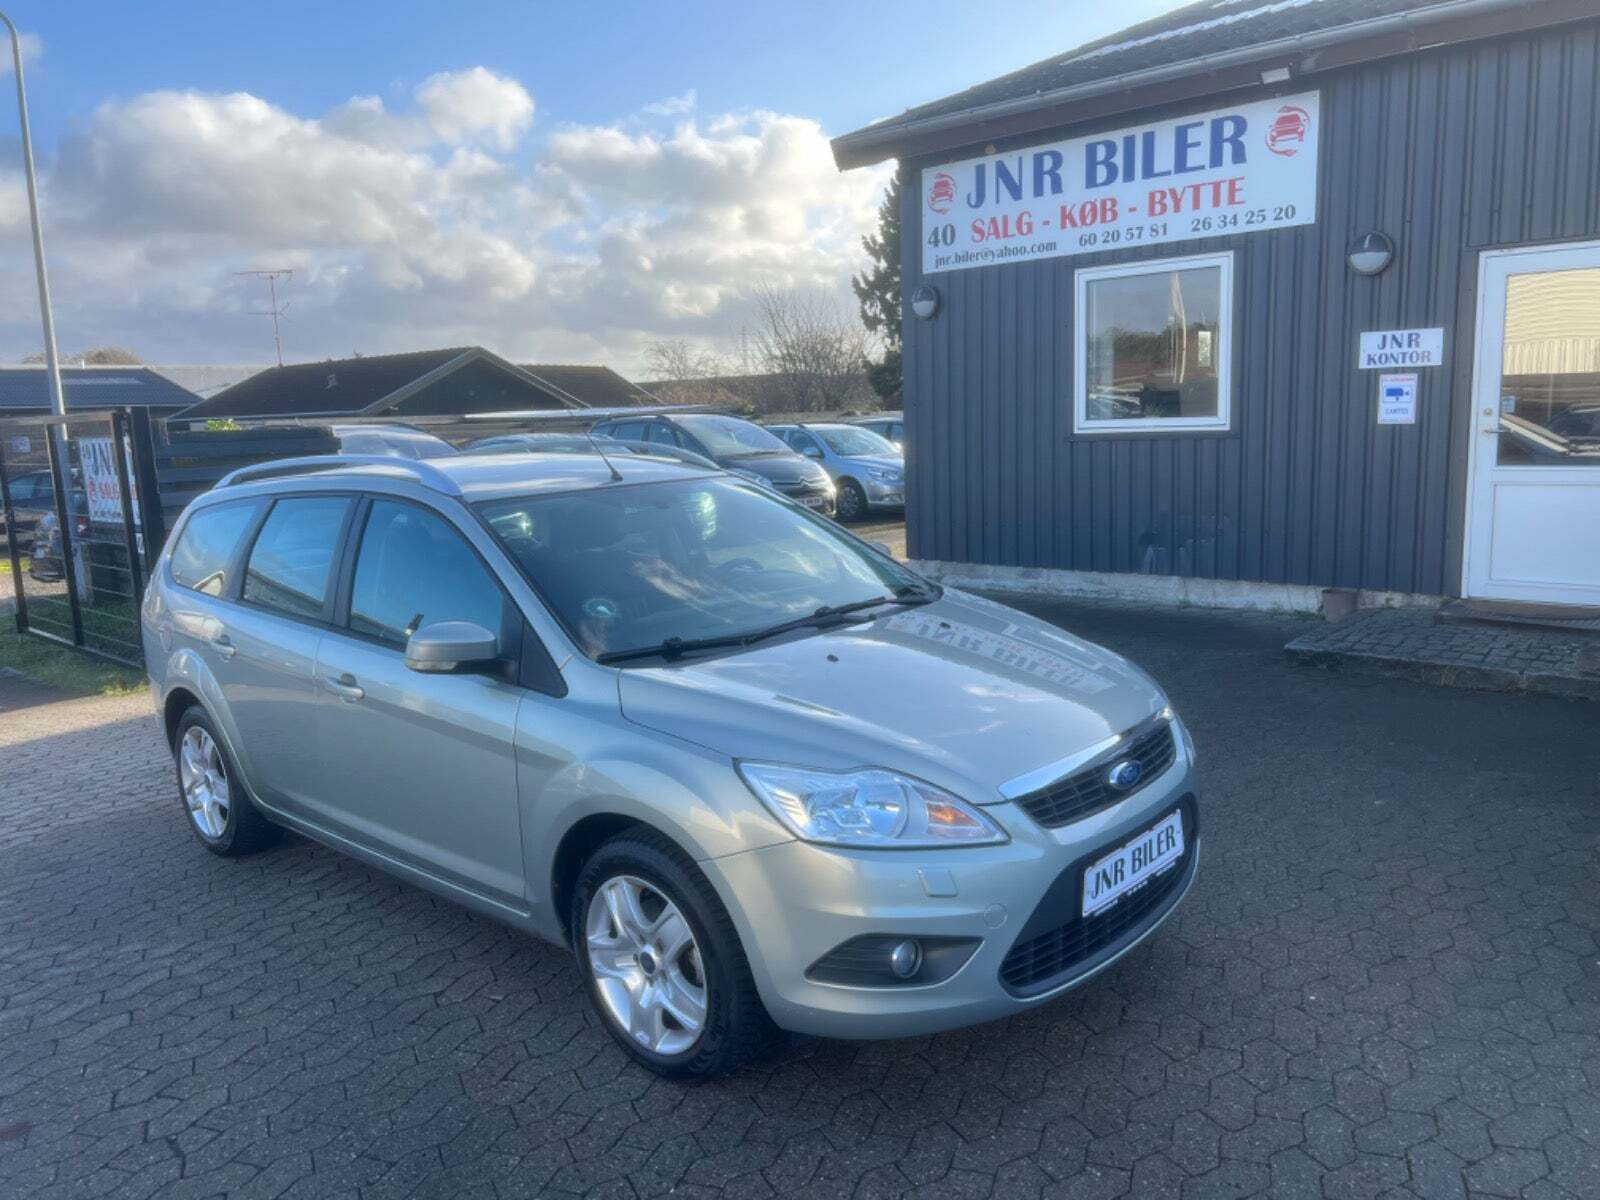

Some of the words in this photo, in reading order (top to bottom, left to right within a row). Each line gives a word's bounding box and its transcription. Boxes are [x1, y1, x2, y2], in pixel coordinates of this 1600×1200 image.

[966, 149, 1063, 209] JNR
[1085, 114, 1249, 189] BILER
[970, 211, 1034, 243] SALG
[1060, 196, 1119, 230] KØB
[1148, 177, 1246, 217] BYTTE
[1191, 217, 1212, 232] 26
[1217, 213, 1238, 229] 34
[1245, 208, 1267, 225] 25
[1273, 204, 1296, 221] 20
[927, 223, 956, 248] 40
[1079, 232, 1097, 247] 60
[1102, 229, 1120, 244] 20
[1125, 226, 1144, 241] 57
[1150, 222, 1168, 237] 81
[935, 240, 1057, 269] jnr.biler@yahoo.com
[1377, 331, 1421, 350] JNR
[1366, 350, 1432, 366] KONTOR
[1090, 858, 1125, 900] JNR
[1131, 824, 1176, 875] BILER
